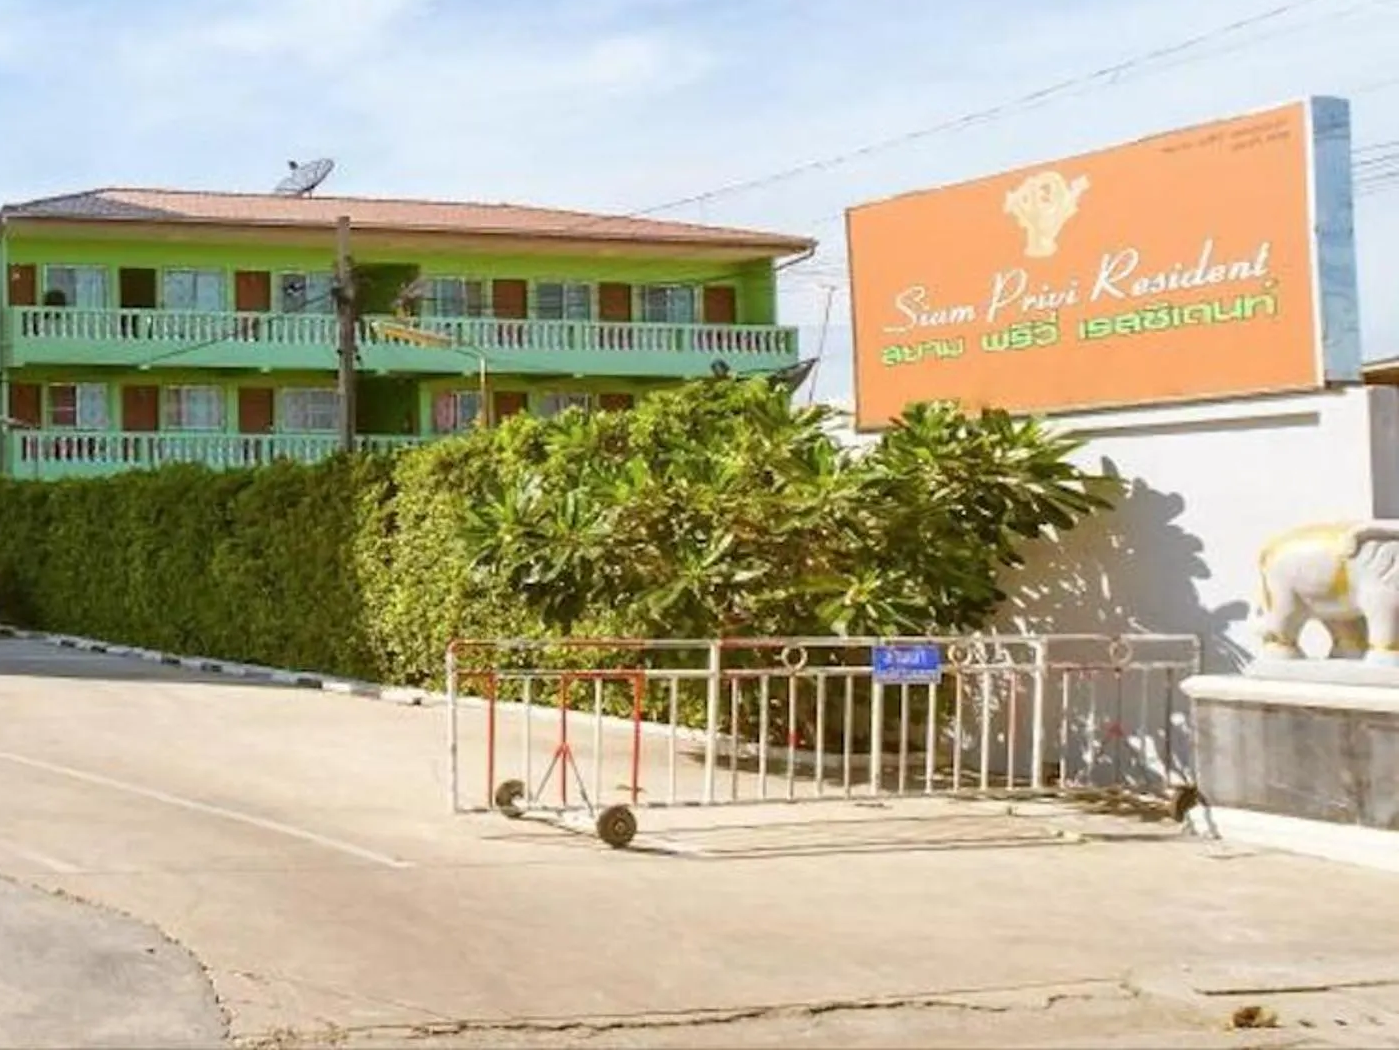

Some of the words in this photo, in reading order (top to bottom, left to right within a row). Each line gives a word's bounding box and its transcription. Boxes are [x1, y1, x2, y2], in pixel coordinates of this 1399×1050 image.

[882, 284, 976, 335] Siam
[986, 268, 1078, 323] Privi
[1089, 237, 1270, 302] Resident
